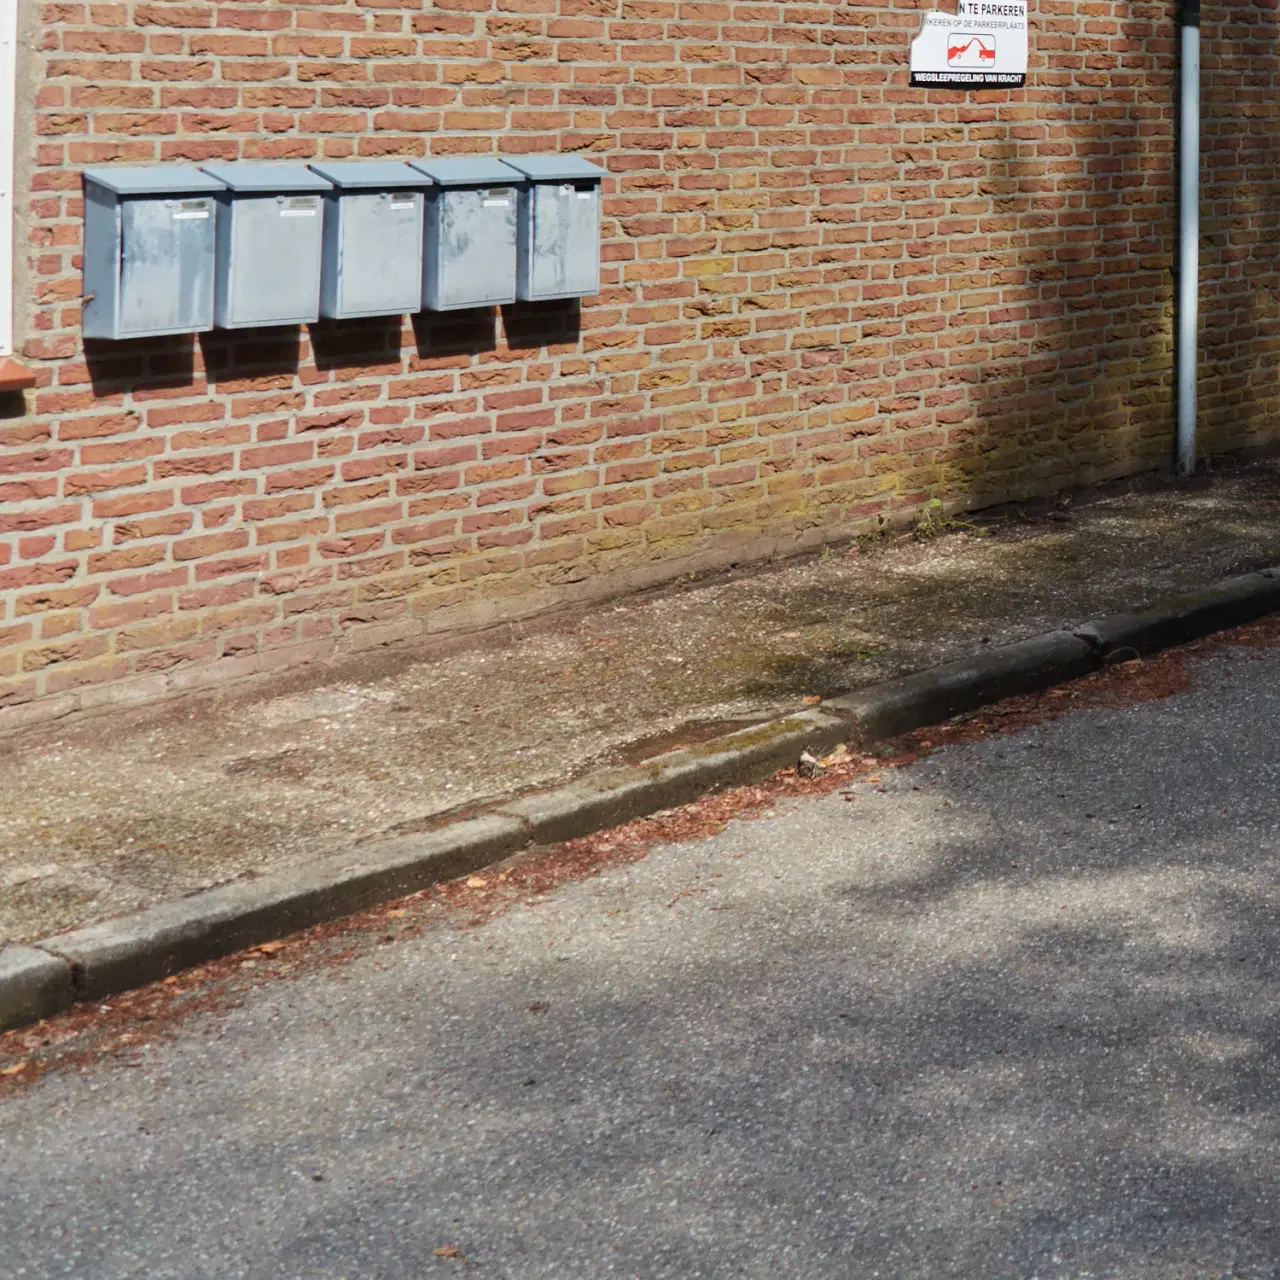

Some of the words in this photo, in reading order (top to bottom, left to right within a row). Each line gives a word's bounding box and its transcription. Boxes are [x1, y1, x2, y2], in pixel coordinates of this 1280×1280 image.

[968, 3, 979, 15] TE
[981, 4, 1025, 17] PARKEREN
[953, 19, 963, 28] OP
[964, 20, 973, 28] DE
[974, 20, 1025, 30] PARKEERPLAATS
[914, 72, 984, 82] WEGSLEEPREGELING
[985, 73, 997, 83] VAN
[998, 74, 1022, 83] KRACHT
